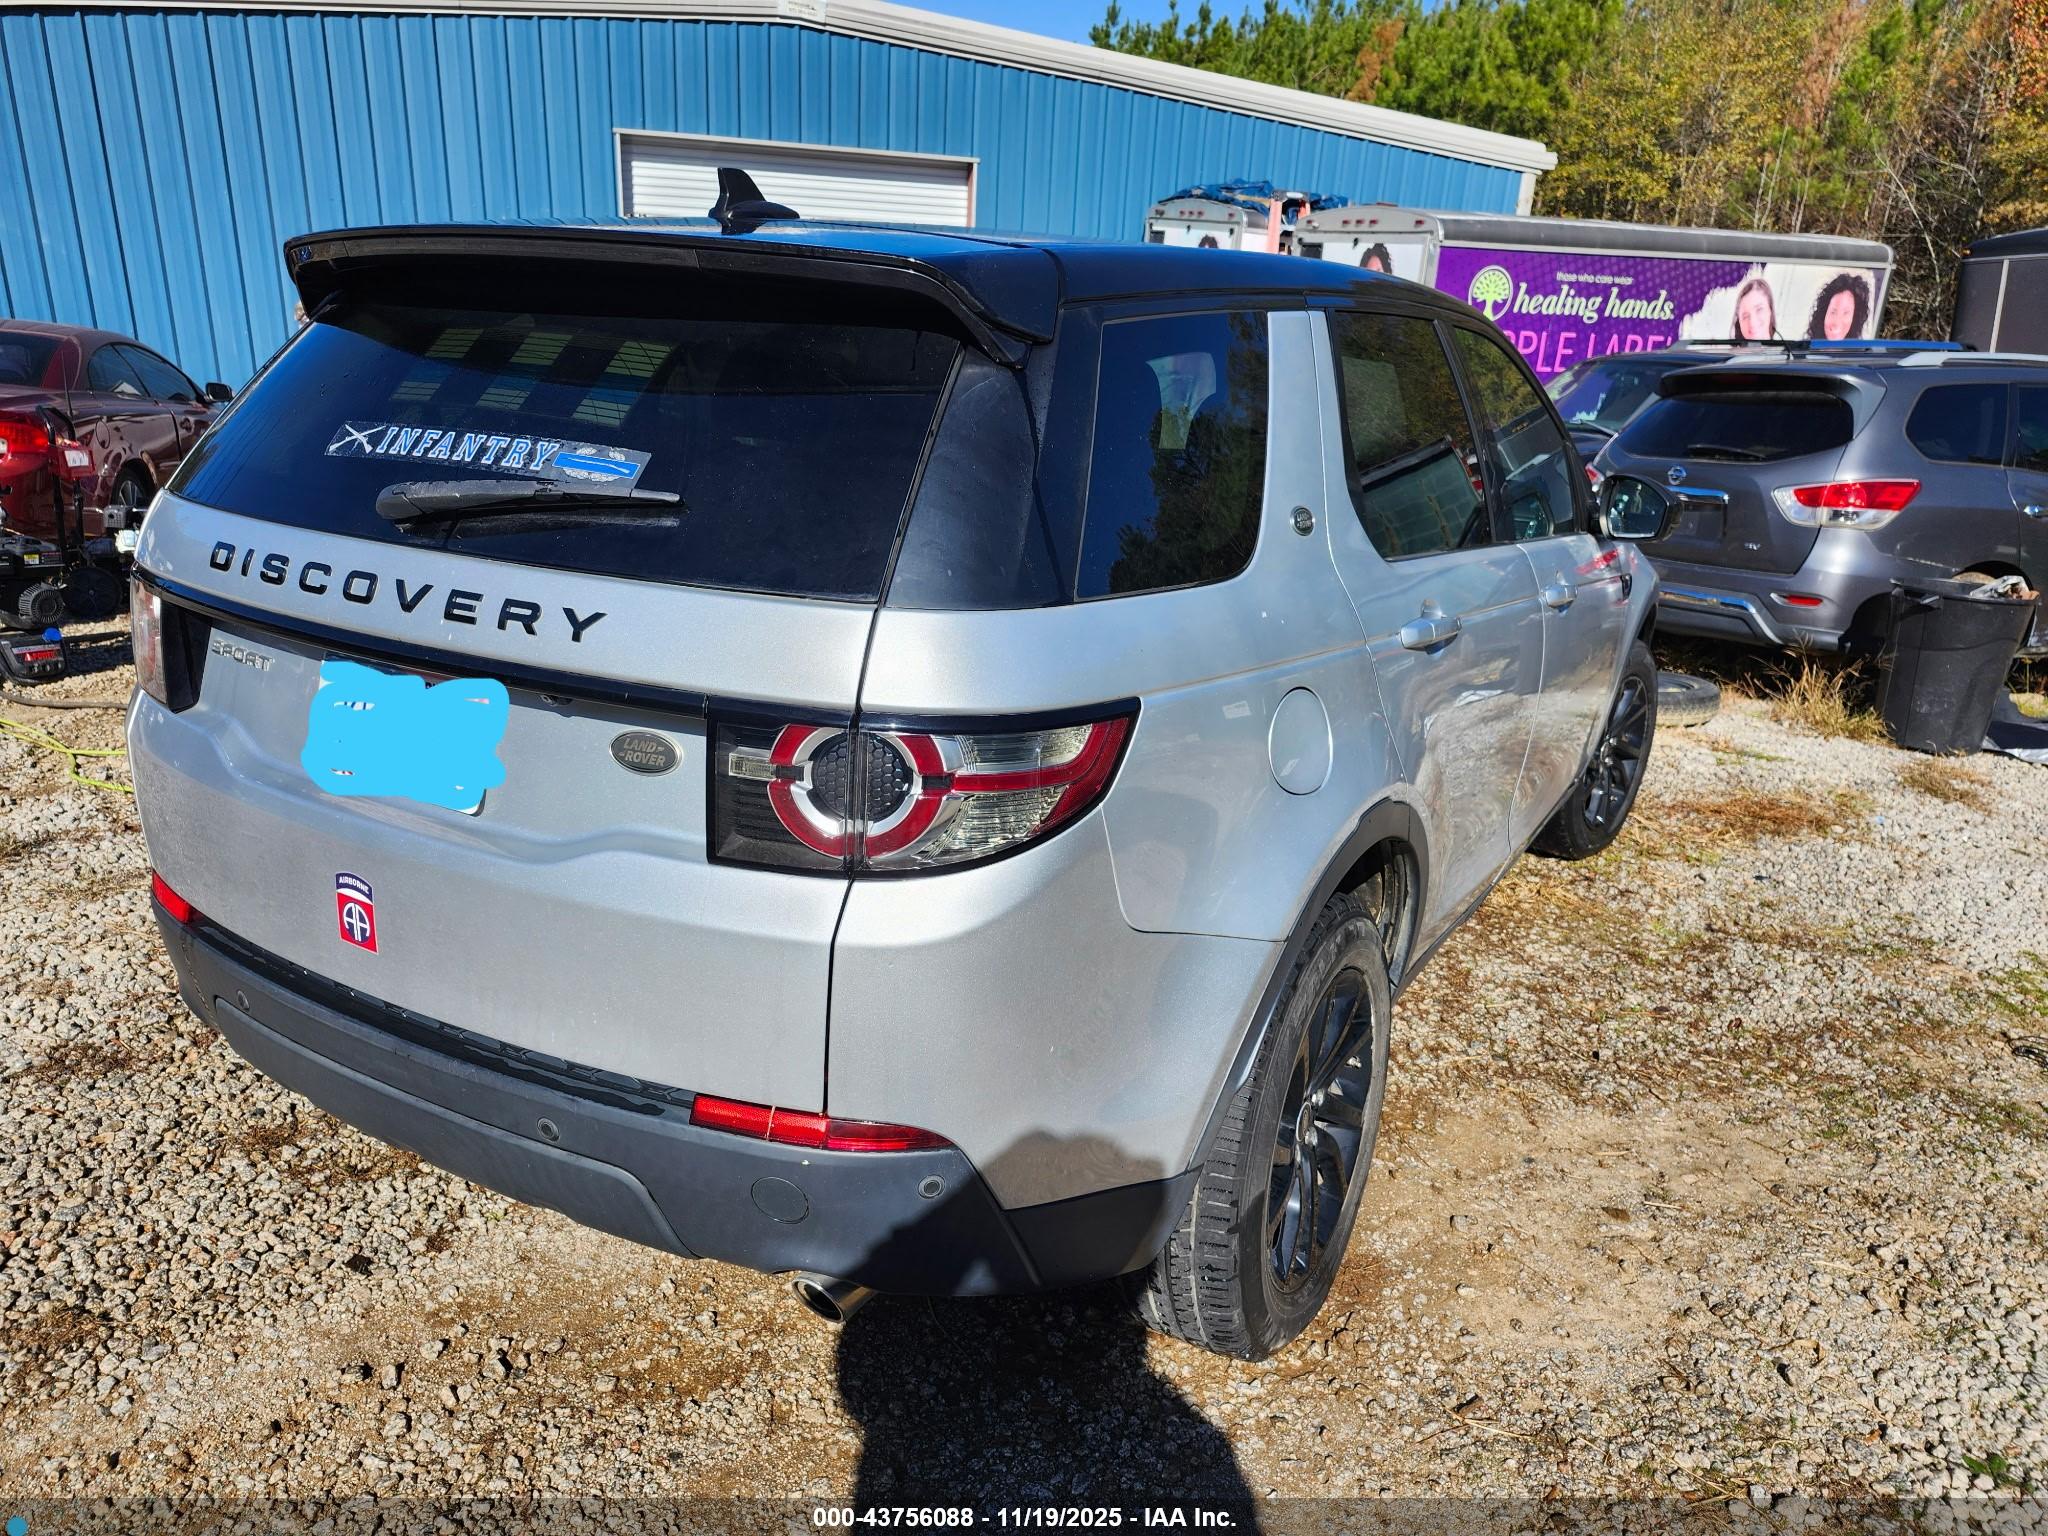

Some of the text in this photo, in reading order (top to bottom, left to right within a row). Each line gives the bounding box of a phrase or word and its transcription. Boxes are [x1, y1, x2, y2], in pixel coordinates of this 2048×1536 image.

[1512, 281, 1602, 323] healing
[376, 426, 559, 471] INFANTRY
[209, 541, 608, 643] DISCOVERY
[211, 639, 274, 672] SPORT
[623, 737, 658, 753] LAND
[624, 750, 666, 767] ROVER
[338, 876, 370, 894] AIRBORNE
